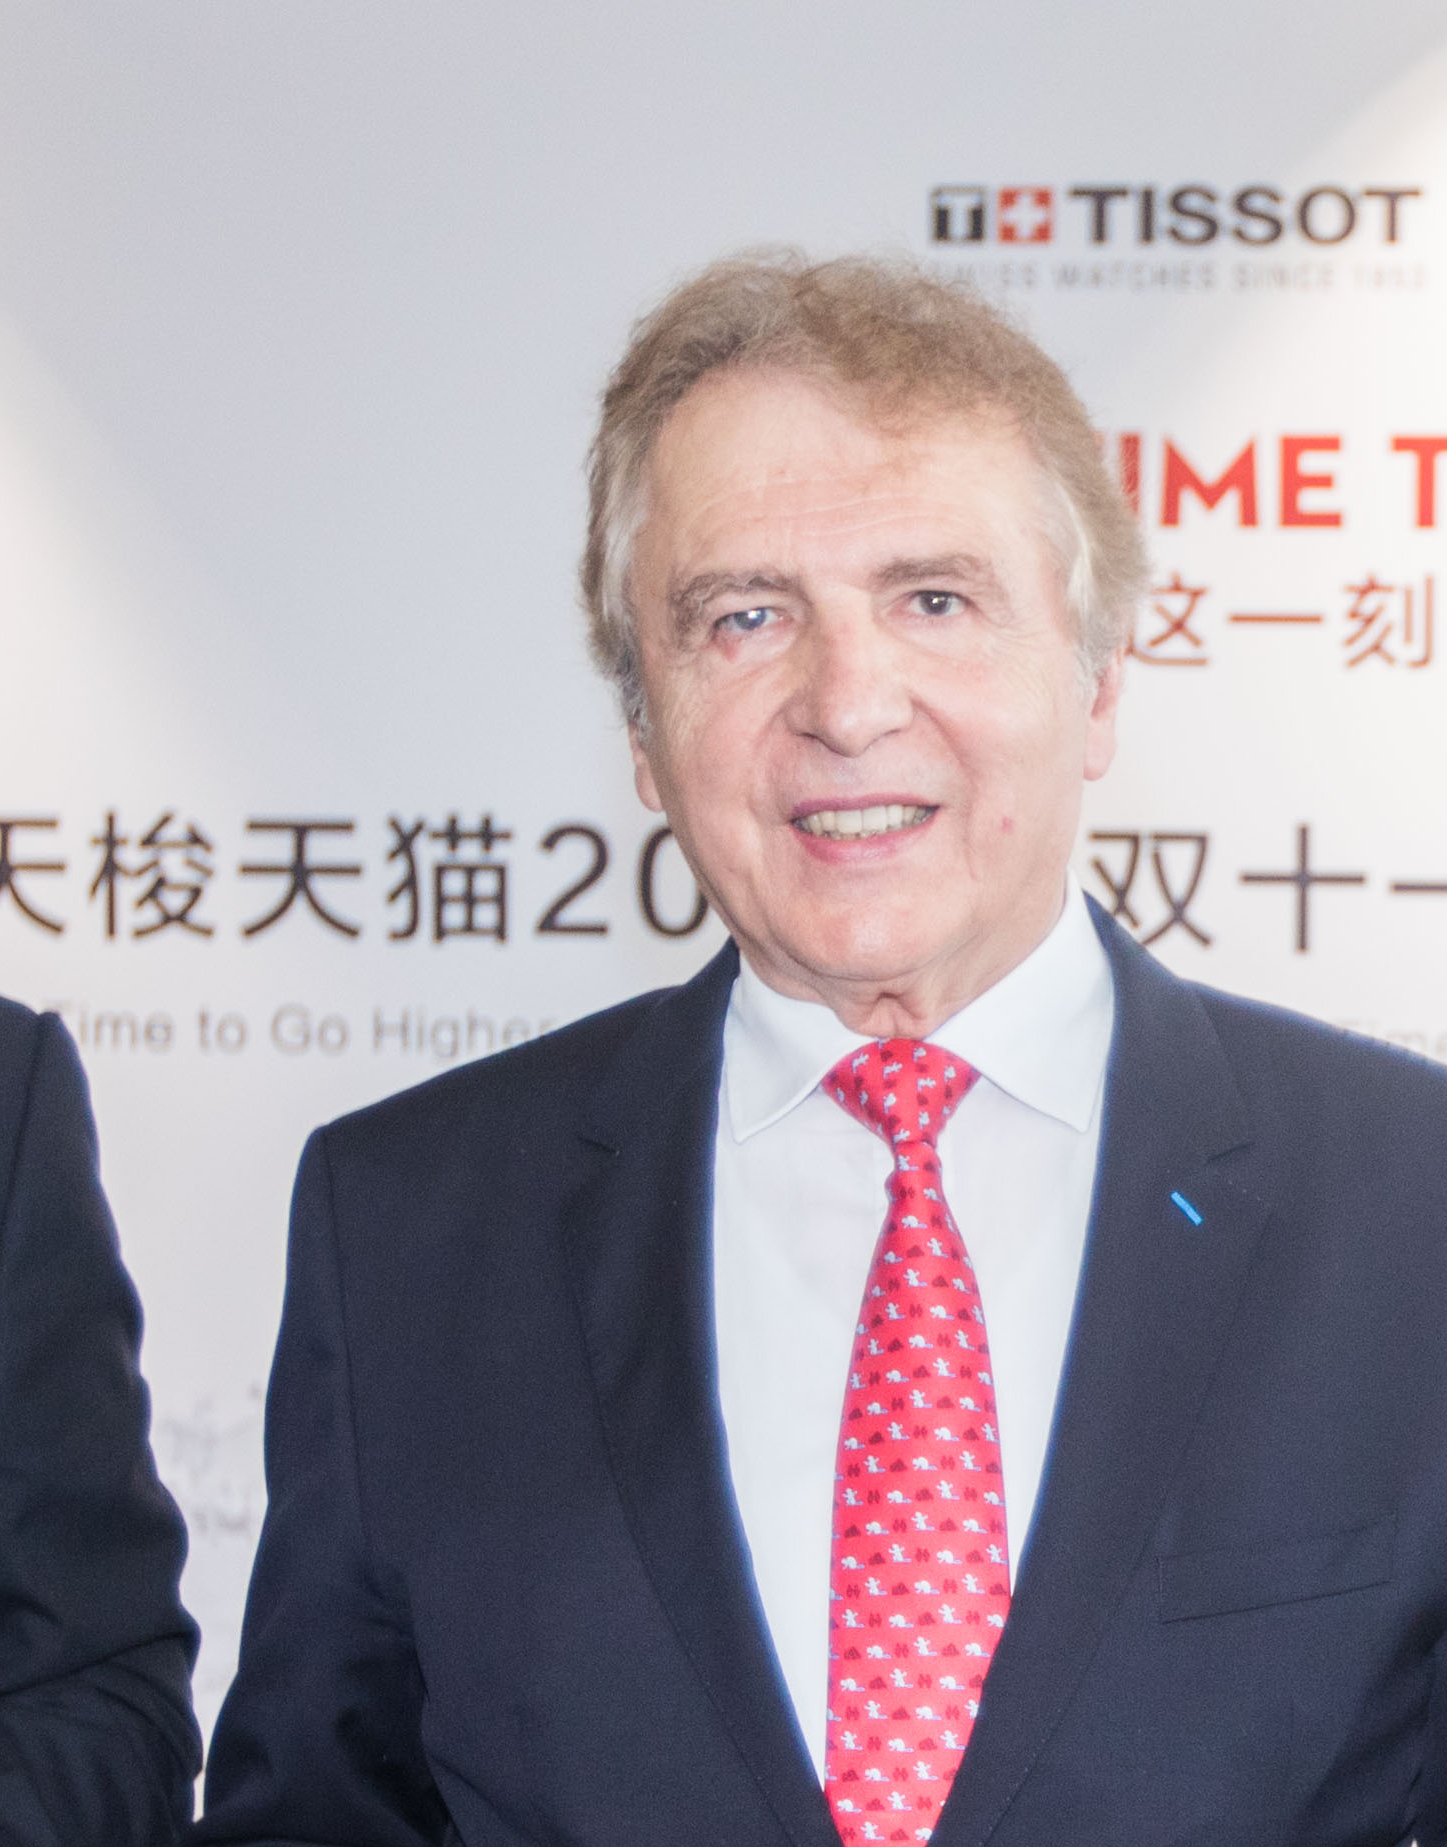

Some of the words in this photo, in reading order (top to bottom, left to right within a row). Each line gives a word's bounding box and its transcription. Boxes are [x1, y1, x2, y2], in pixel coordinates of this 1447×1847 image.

[1068, 186, 1423, 245] TISSOT
[1099, 432, 1343, 530] IME
[198, 1005, 248, 1053] to
[270, 1004, 350, 1057] Go
